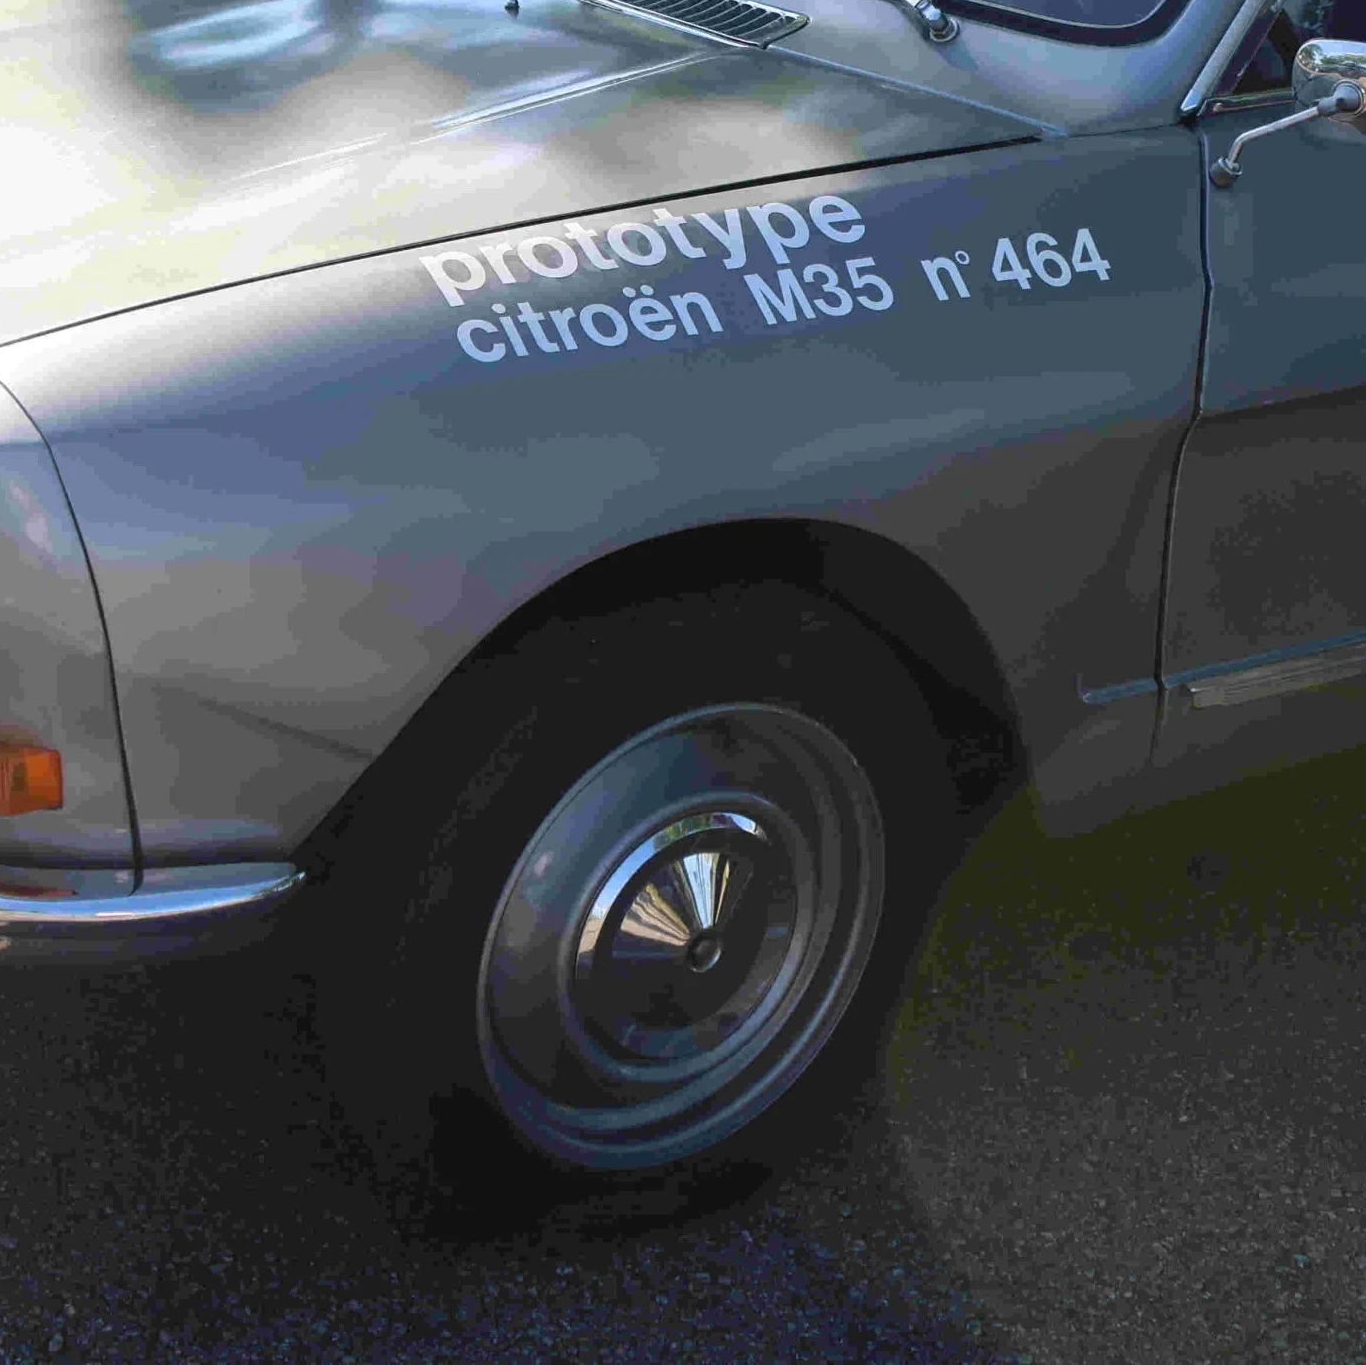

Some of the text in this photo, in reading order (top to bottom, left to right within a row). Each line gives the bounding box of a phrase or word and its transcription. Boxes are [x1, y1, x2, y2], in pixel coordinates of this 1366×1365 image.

[419, 192, 866, 307] prototype
[455, 285, 724, 363] citroën
[742, 255, 895, 326] M35
[990, 227, 1112, 293] 464
